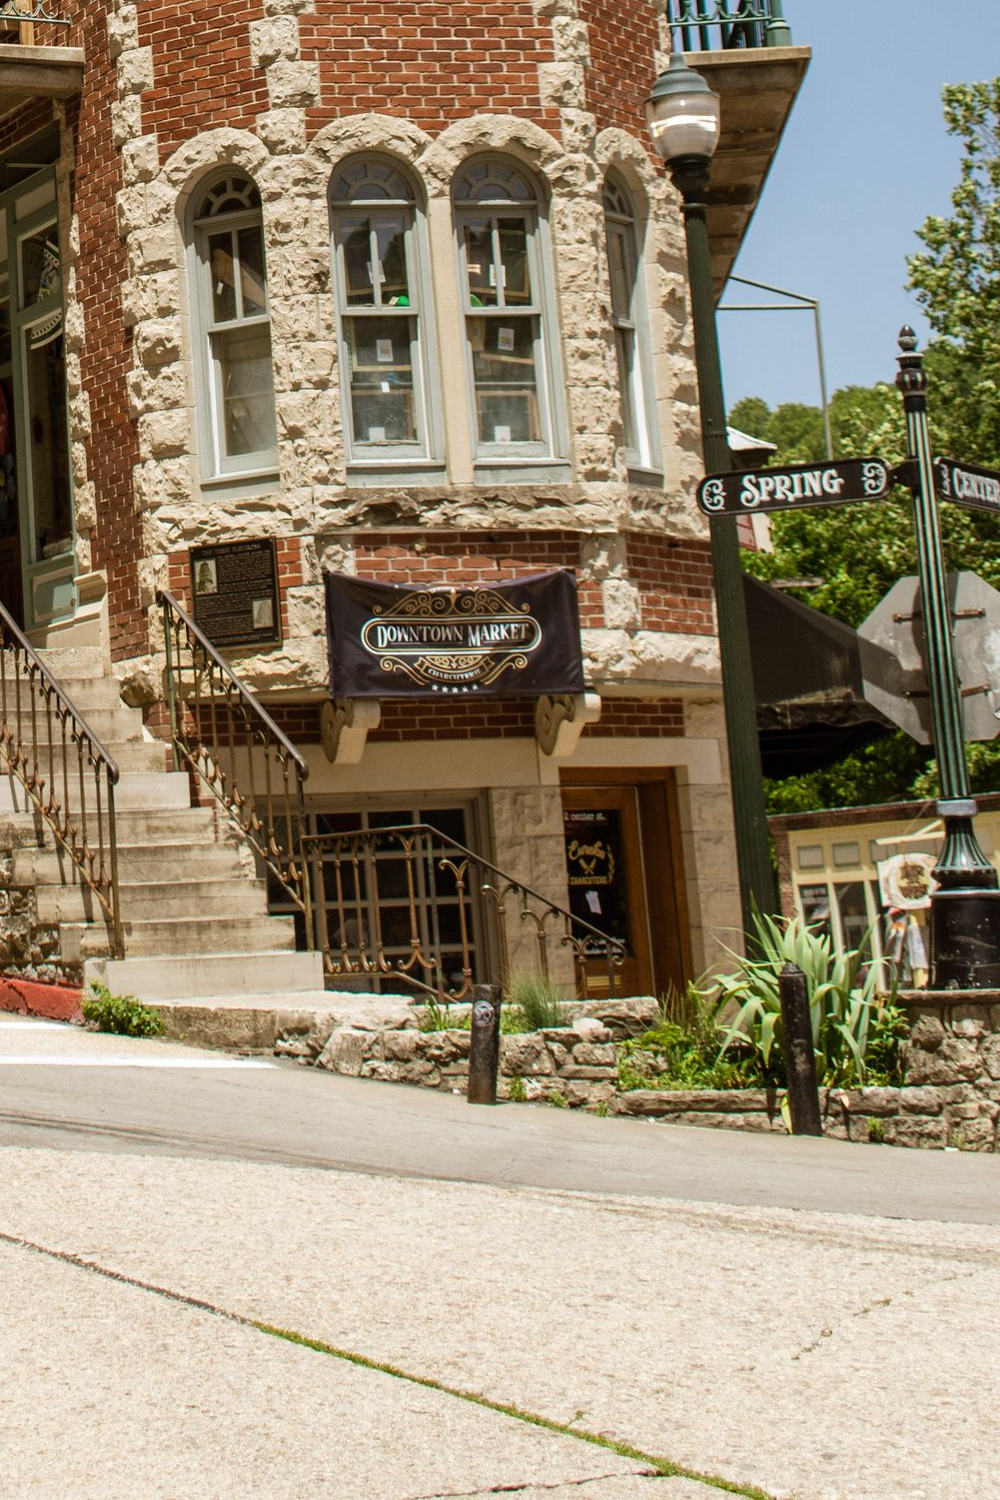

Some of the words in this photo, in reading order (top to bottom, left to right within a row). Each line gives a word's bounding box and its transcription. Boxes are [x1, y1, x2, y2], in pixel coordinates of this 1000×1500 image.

[740, 468, 845, 508] SPRING
[376, 624, 464, 648] DOWNTOWN
[467, 623, 530, 647] MARKET
